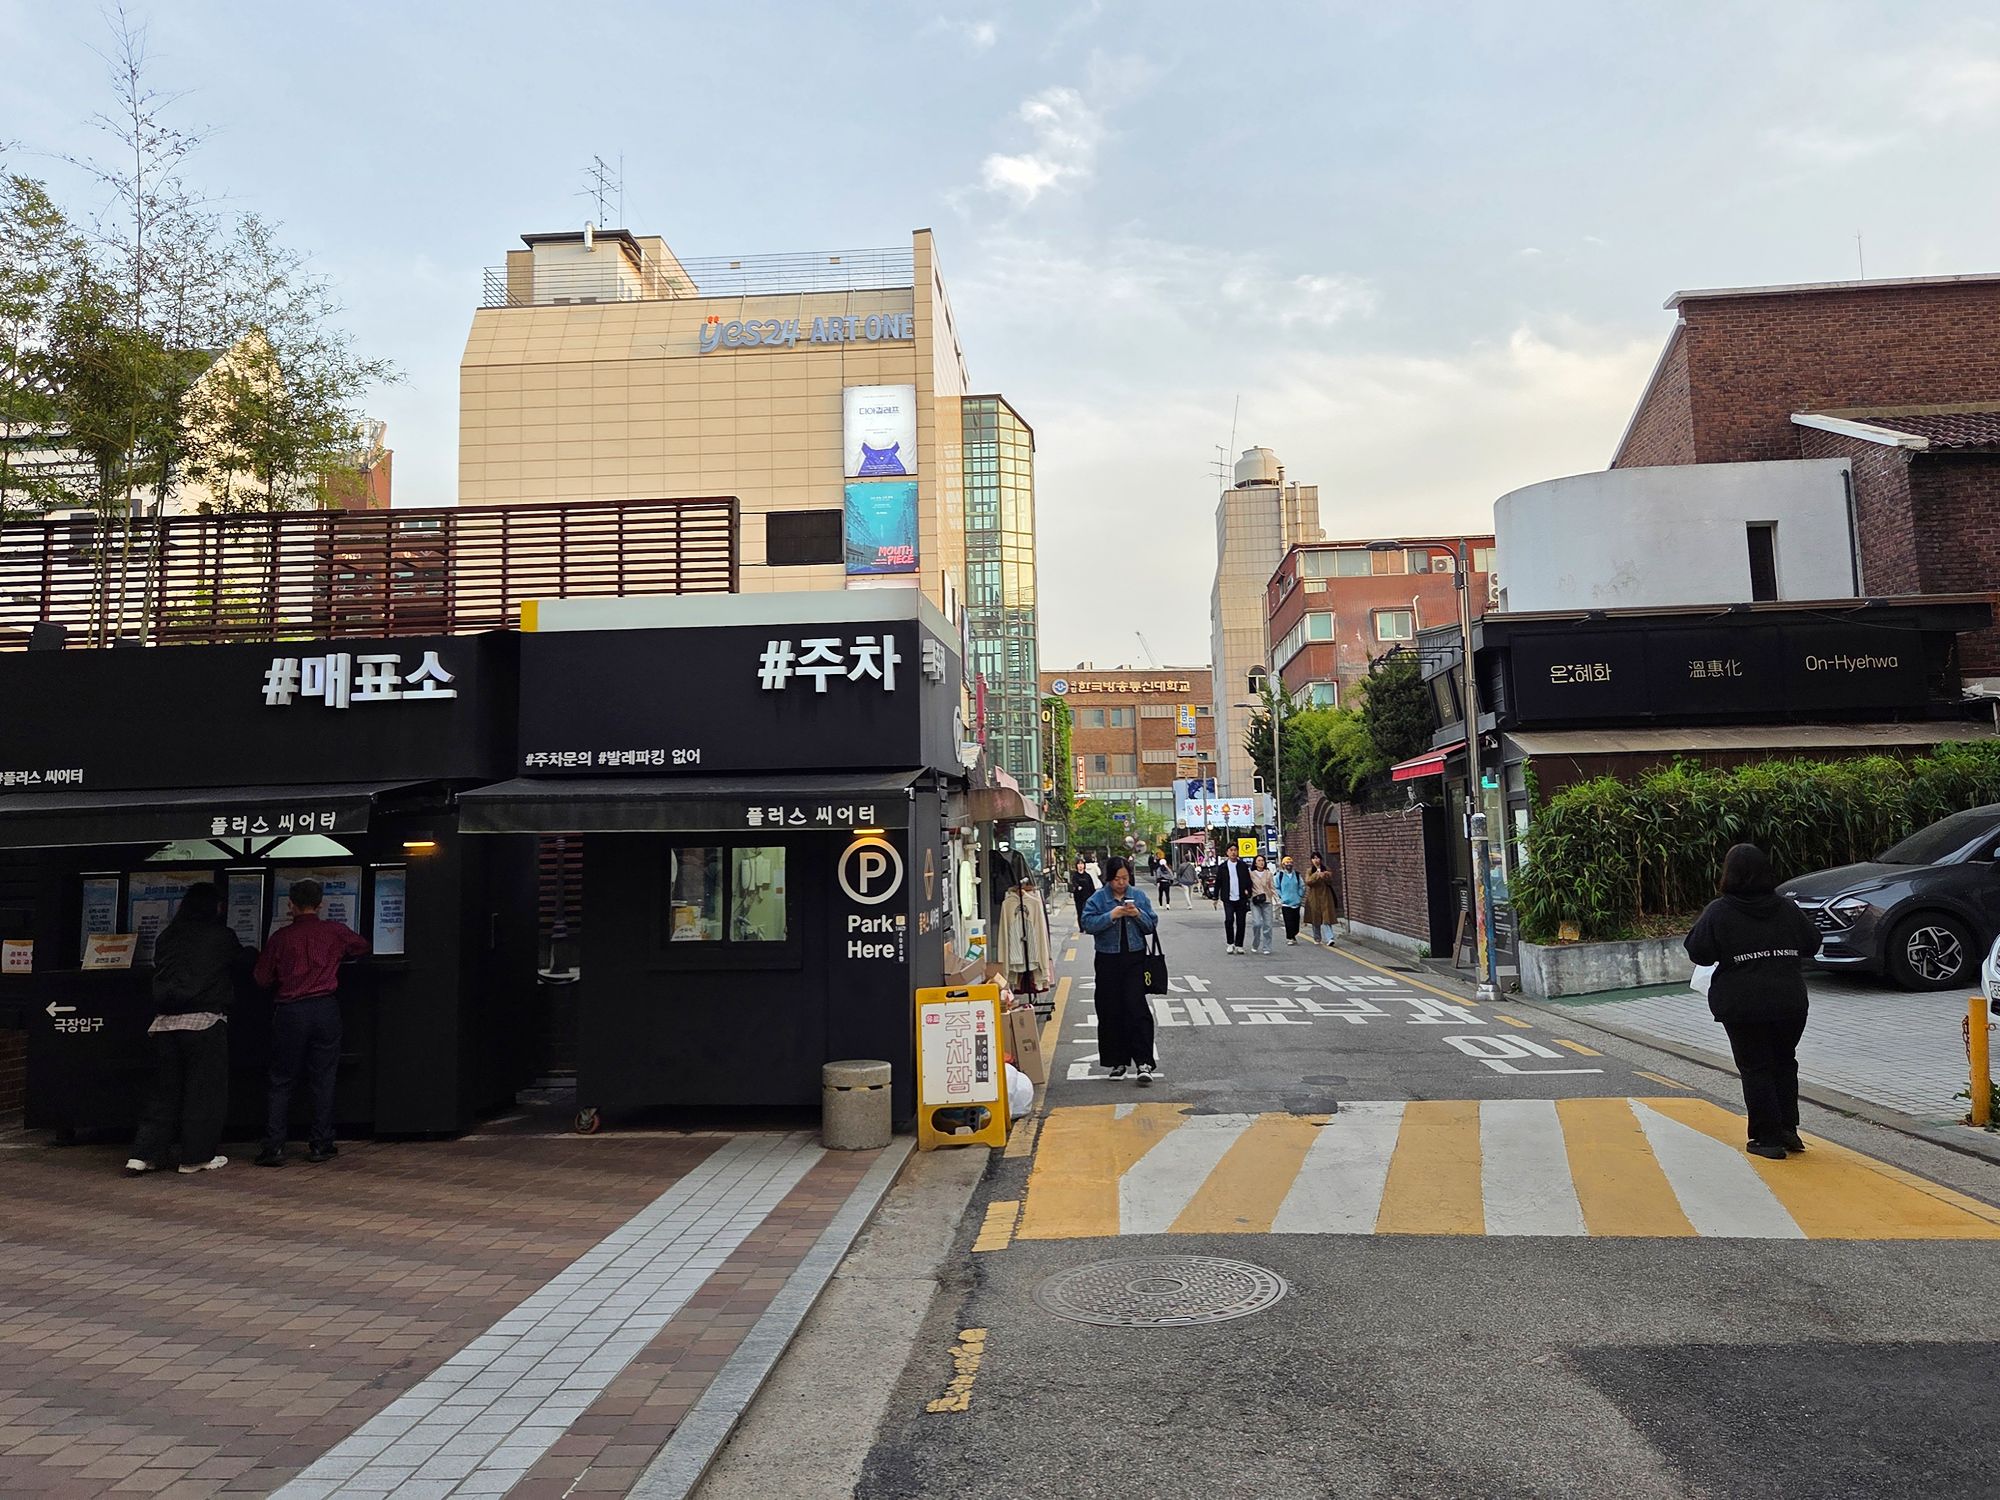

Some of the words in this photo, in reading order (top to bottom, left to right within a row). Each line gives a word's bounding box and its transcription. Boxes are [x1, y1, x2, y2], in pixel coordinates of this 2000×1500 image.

[699, 316, 800, 353] yes24
[810, 316, 860, 343] ART
[864, 313, 914, 342] ONE
[878, 545, 914, 557] MOUTH
[887, 555, 914, 565] PIECE
[757, 635, 901, 692] #주차
[1688, 659, 1742, 678] 溫惠化
[1806, 655, 1898, 671] On-Hyehwa
[262, 651, 457, 708] #매표소
[525, 751, 592, 767] #주차문의
[598, 749, 665, 765] #발레파킹
[671, 748, 701, 765] 없어
[44, 768, 83, 784] 씨어터
[211, 816, 269, 835] 플러스
[278, 811, 336, 832] 씨어터
[746, 806, 807, 826] 플러스
[816, 805, 875, 825] 씨어터
[847, 915, 893, 933] Park
[847, 940, 895, 959] Here
[1264, 974, 1413, 993] 위반
[54, 1018, 104, 1033] 극장입구
[945, 1010, 972, 1094] 주차장
